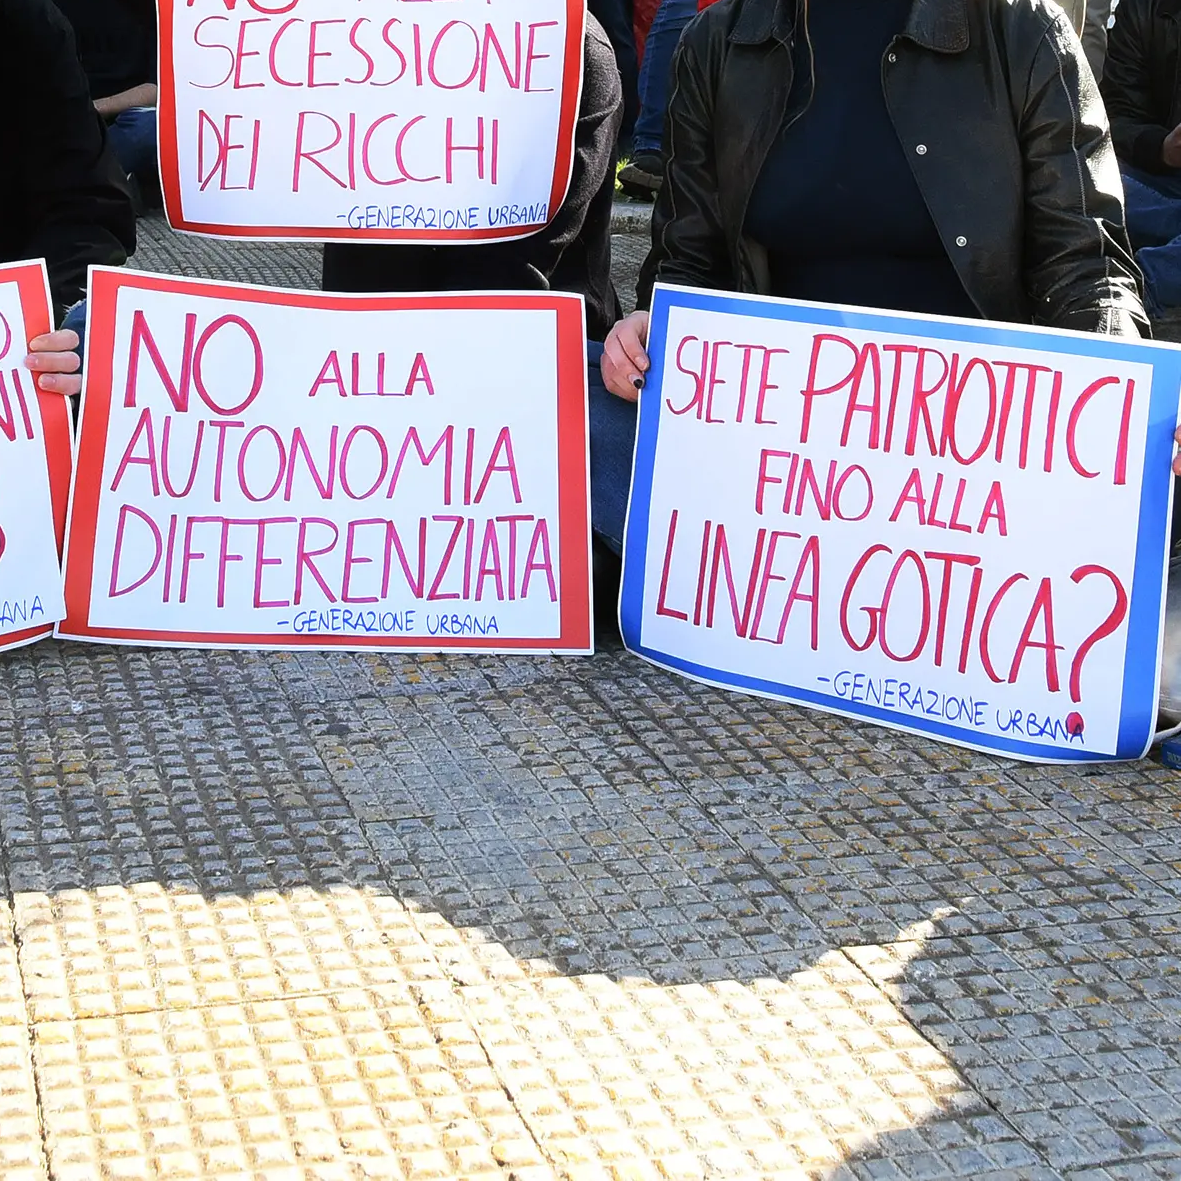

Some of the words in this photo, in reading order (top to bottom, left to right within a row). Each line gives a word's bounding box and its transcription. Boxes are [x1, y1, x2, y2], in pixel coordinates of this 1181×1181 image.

[188, 15, 559, 93] SECESSIONE
[198, 109, 261, 192] DEI
[291, 111, 499, 192] RICCHI
[336, 204, 479, 230] -GENERAZIONE
[487, 202, 548, 226] URBANA
[124, 310, 264, 416] NO
[309, 351, 435, 397] ALLA
[666, 335, 790, 425] SIETE
[800, 333, 1136, 486] PATRIOTTICI
[110, 407, 523, 506] AUTONOMIA
[755, 449, 875, 522] FINO
[888, 468, 1009, 537] ALLA
[108, 504, 558, 608] DIFFERENZIATA
[277, 608, 417, 633] -GENERAZIONE
[426, 613, 500, 636] URBANA
[656, 509, 820, 651] LINEA
[839, 543, 1128, 735] GOTICA?
[817, 670, 988, 727] -GENERAZIONE
[996, 707, 1086, 745] URBANA
